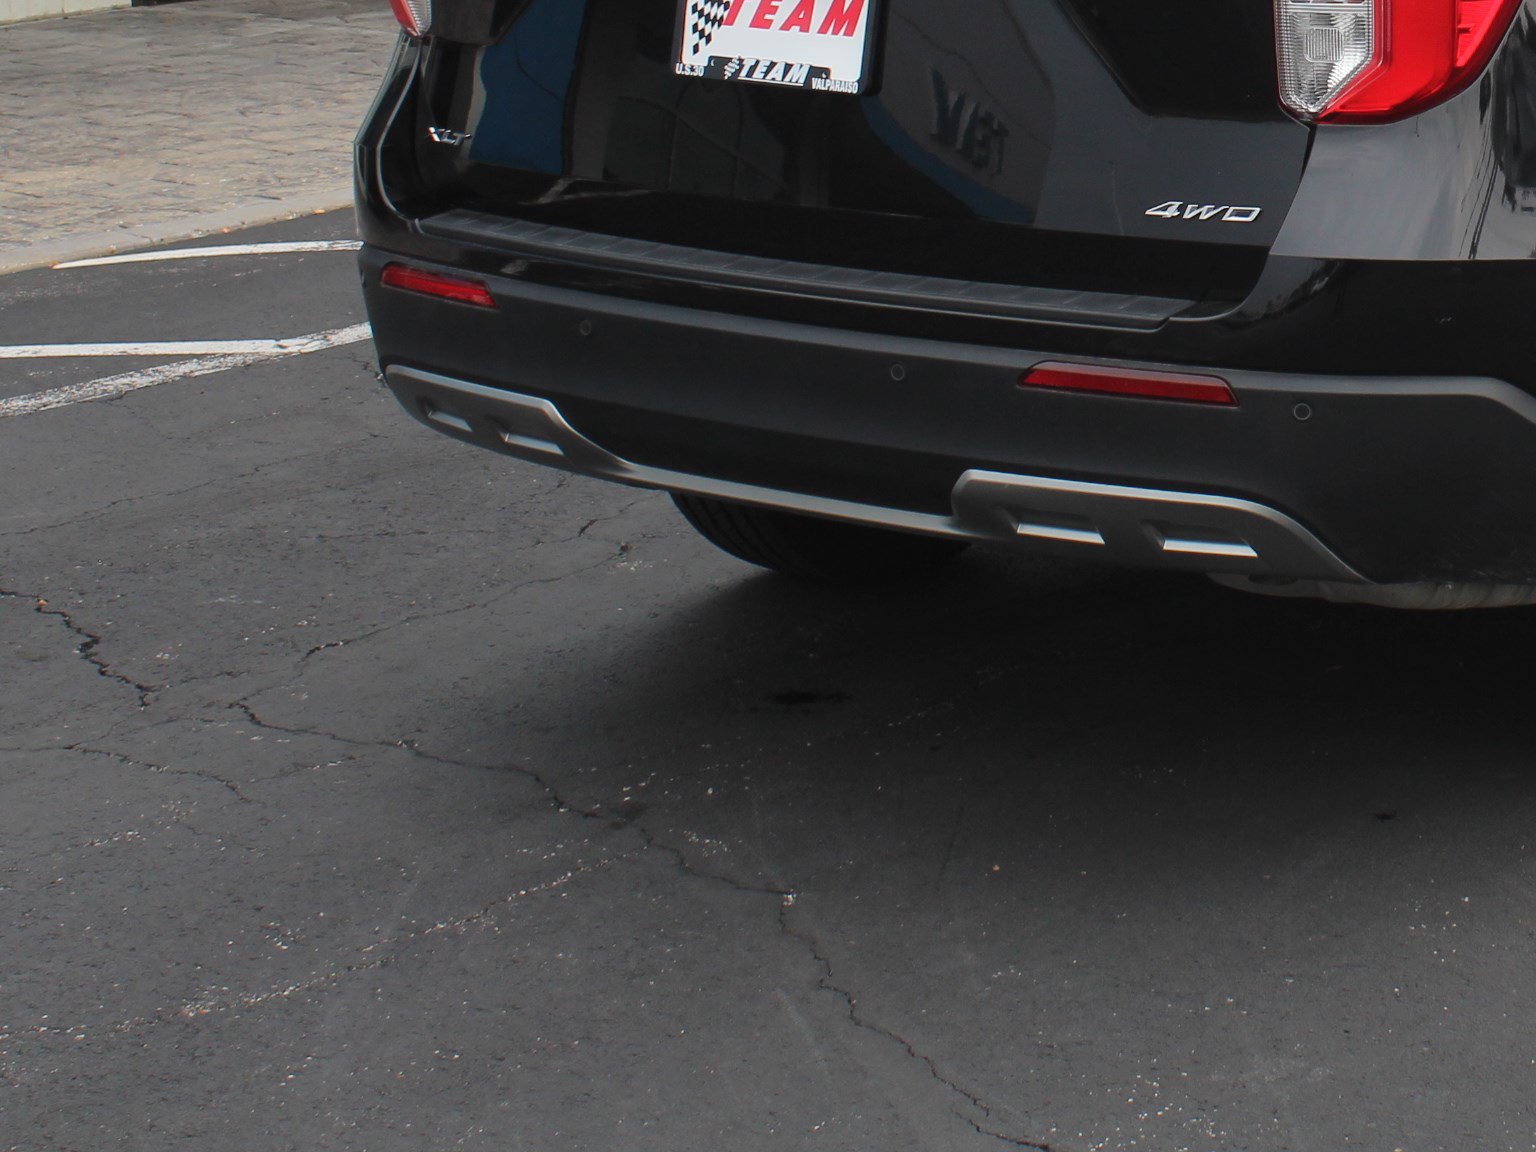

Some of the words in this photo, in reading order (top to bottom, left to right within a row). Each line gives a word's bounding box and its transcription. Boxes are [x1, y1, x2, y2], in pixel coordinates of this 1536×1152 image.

[738, 57, 812, 85] TEAM
[811, 77, 860, 95] VALPARAISO
[1145, 201, 1263, 223] 4WD
